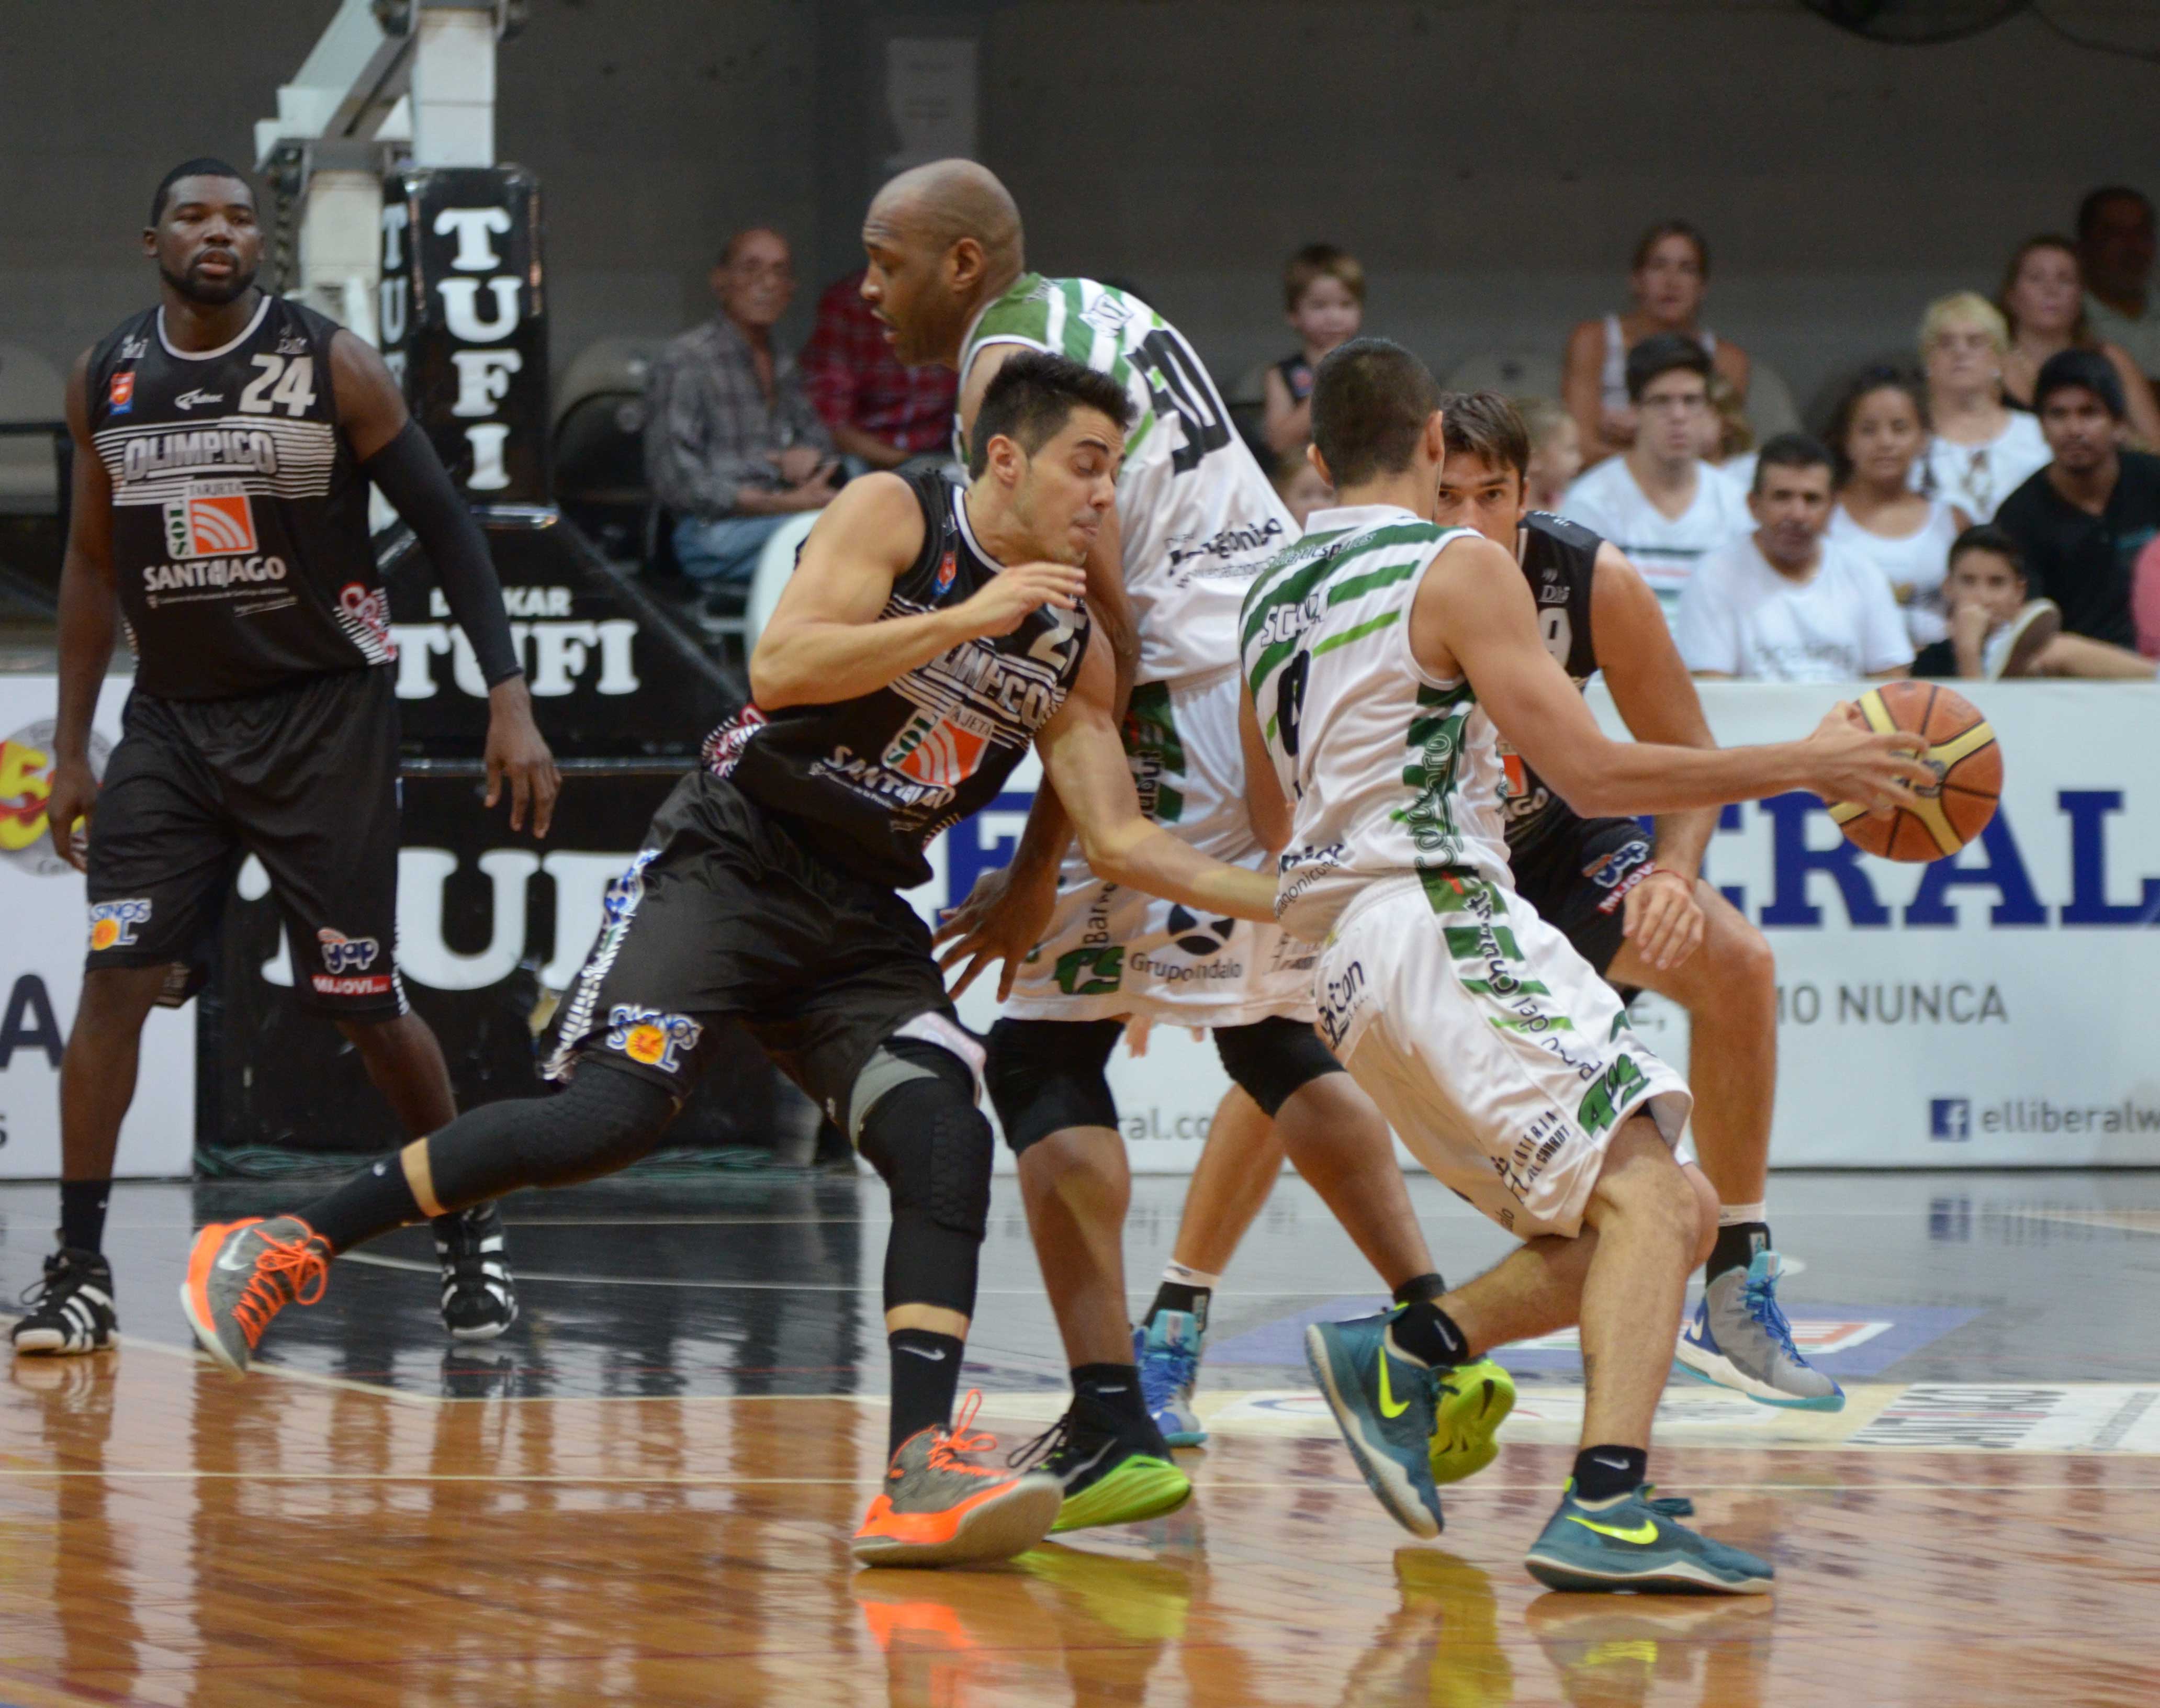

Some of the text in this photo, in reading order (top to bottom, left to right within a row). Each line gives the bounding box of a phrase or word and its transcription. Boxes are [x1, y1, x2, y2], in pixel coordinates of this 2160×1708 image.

[433, 207, 523, 491] TUFI
[238, 353, 317, 417] 24
[123, 429, 278, 482] OLIMPICO
[325, 941, 375, 972] yap
[1510, 996, 1550, 1033] del
[1837, 984, 2008, 1025] NUNCA
